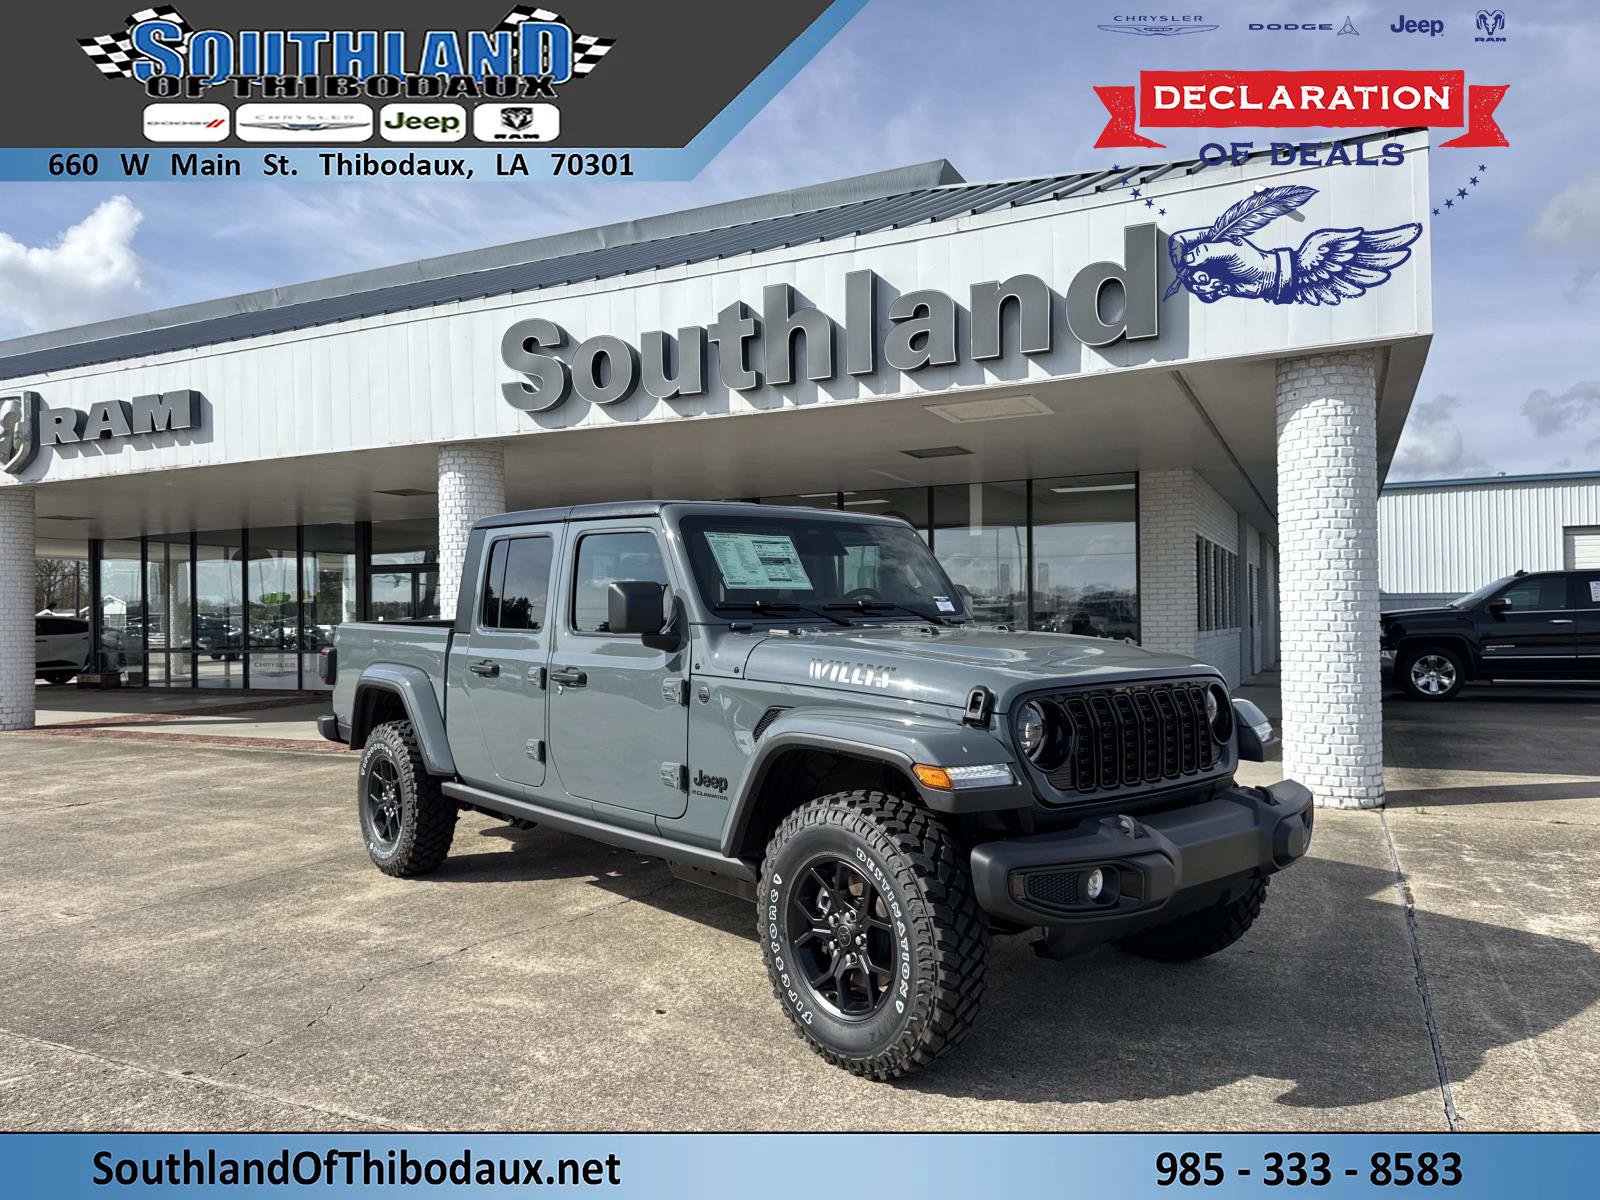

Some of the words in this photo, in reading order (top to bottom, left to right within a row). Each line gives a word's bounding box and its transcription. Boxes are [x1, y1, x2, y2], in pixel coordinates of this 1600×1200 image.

[500, 222, 1160, 413] Southland
[40, 389, 201, 446] RAM
[693, 769, 729, 794] Jeep
[856, 848, 911, 999] DESTINATION
